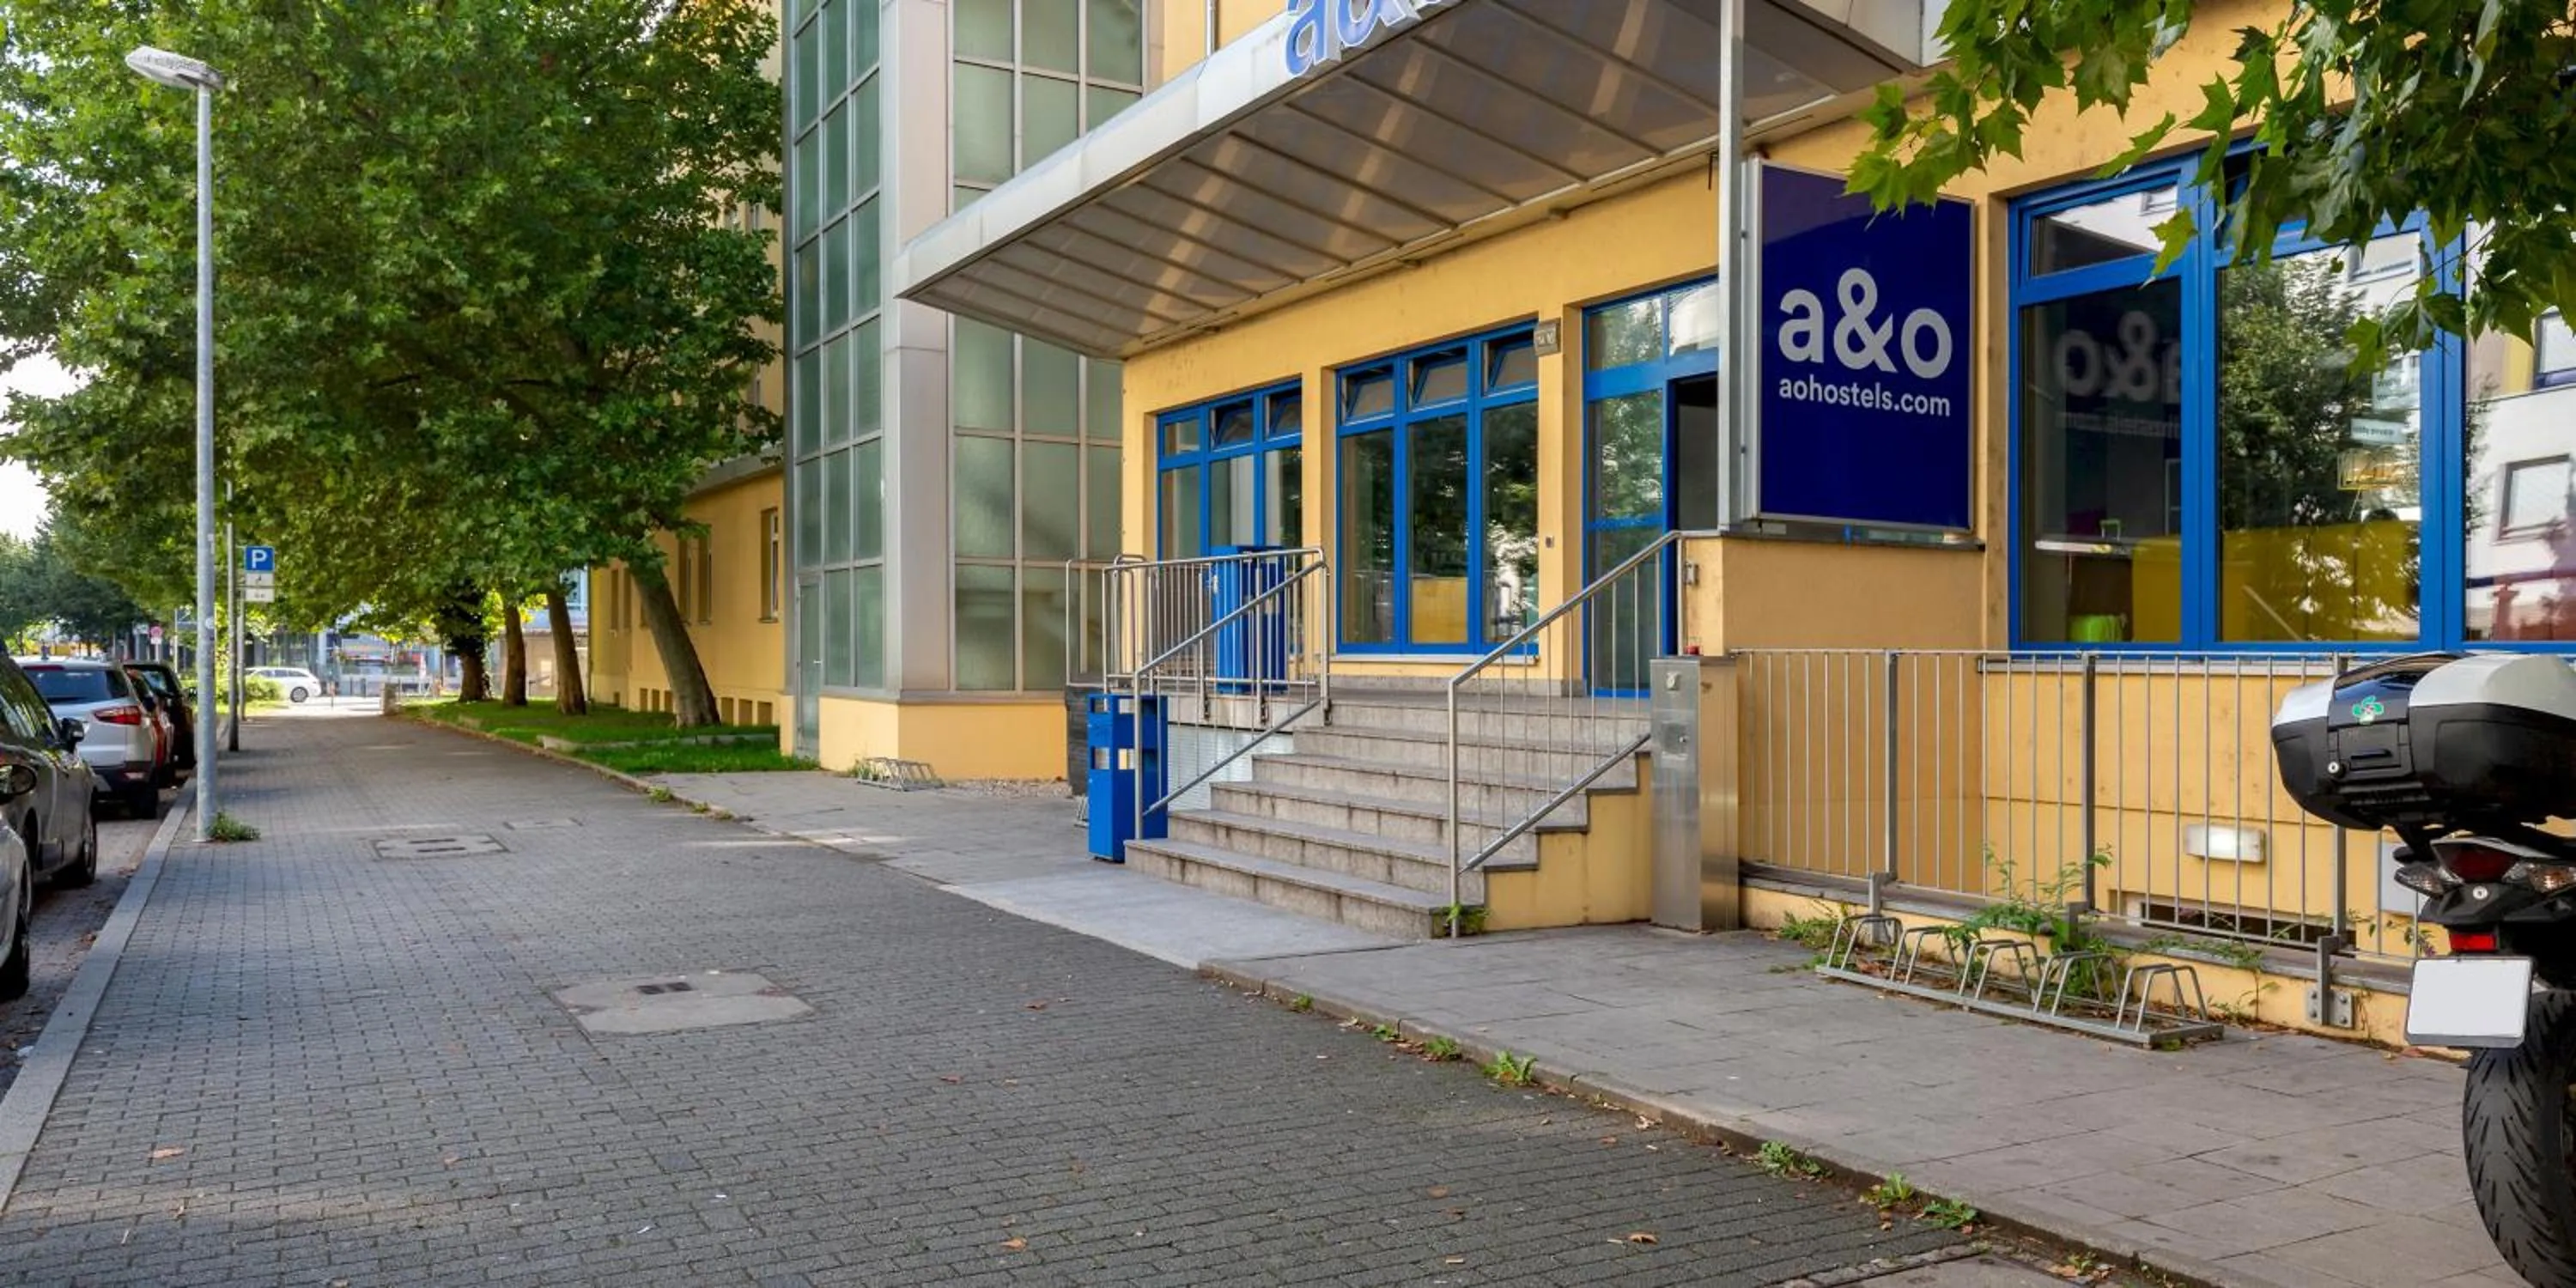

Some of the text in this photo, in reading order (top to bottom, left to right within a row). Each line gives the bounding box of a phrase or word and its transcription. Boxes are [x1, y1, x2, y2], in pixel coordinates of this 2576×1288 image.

[1778, 267, 1953, 379] a&o
[1778, 374, 1951, 417] aohostels.com
[252, 549, 267, 569] P
